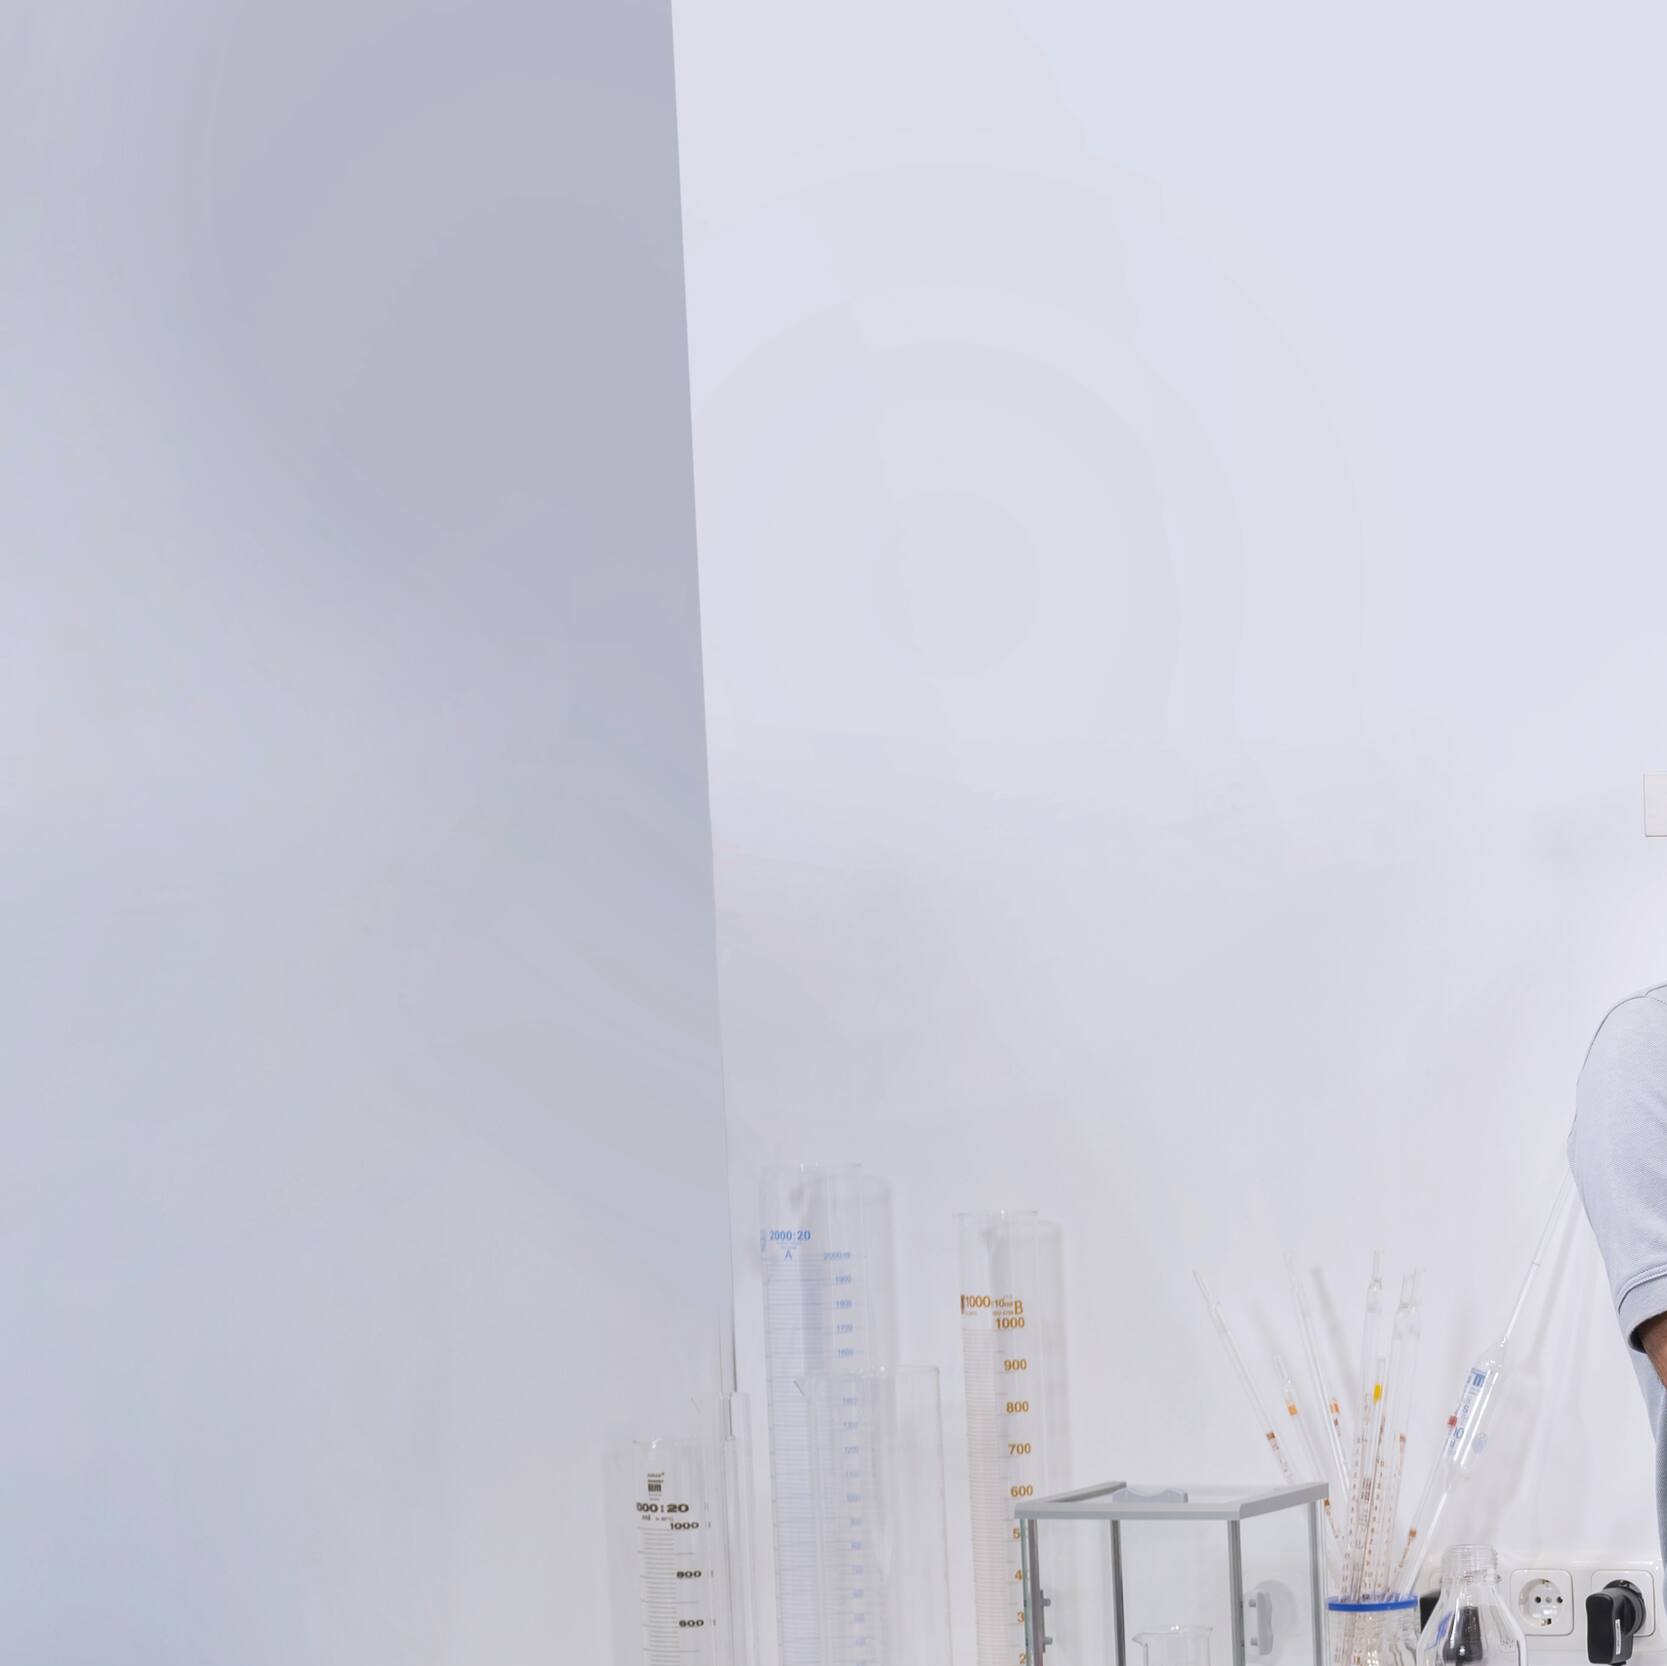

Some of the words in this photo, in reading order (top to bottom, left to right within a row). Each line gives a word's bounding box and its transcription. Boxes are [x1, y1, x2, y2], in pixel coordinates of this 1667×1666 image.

[1014, 1300, 1024, 1315] B
[996, 1317, 1025, 1329] 1000
[1004, 1359, 1028, 1372] 900
[1006, 1401, 1030, 1413] 800
[1008, 1443, 1032, 1455] 700
[1010, 1486, 1034, 1497] 600
[670, 1522, 700, 1530] 1000
[676, 1570, 702, 1579] 800
[678, 1619, 705, 1628] 600
